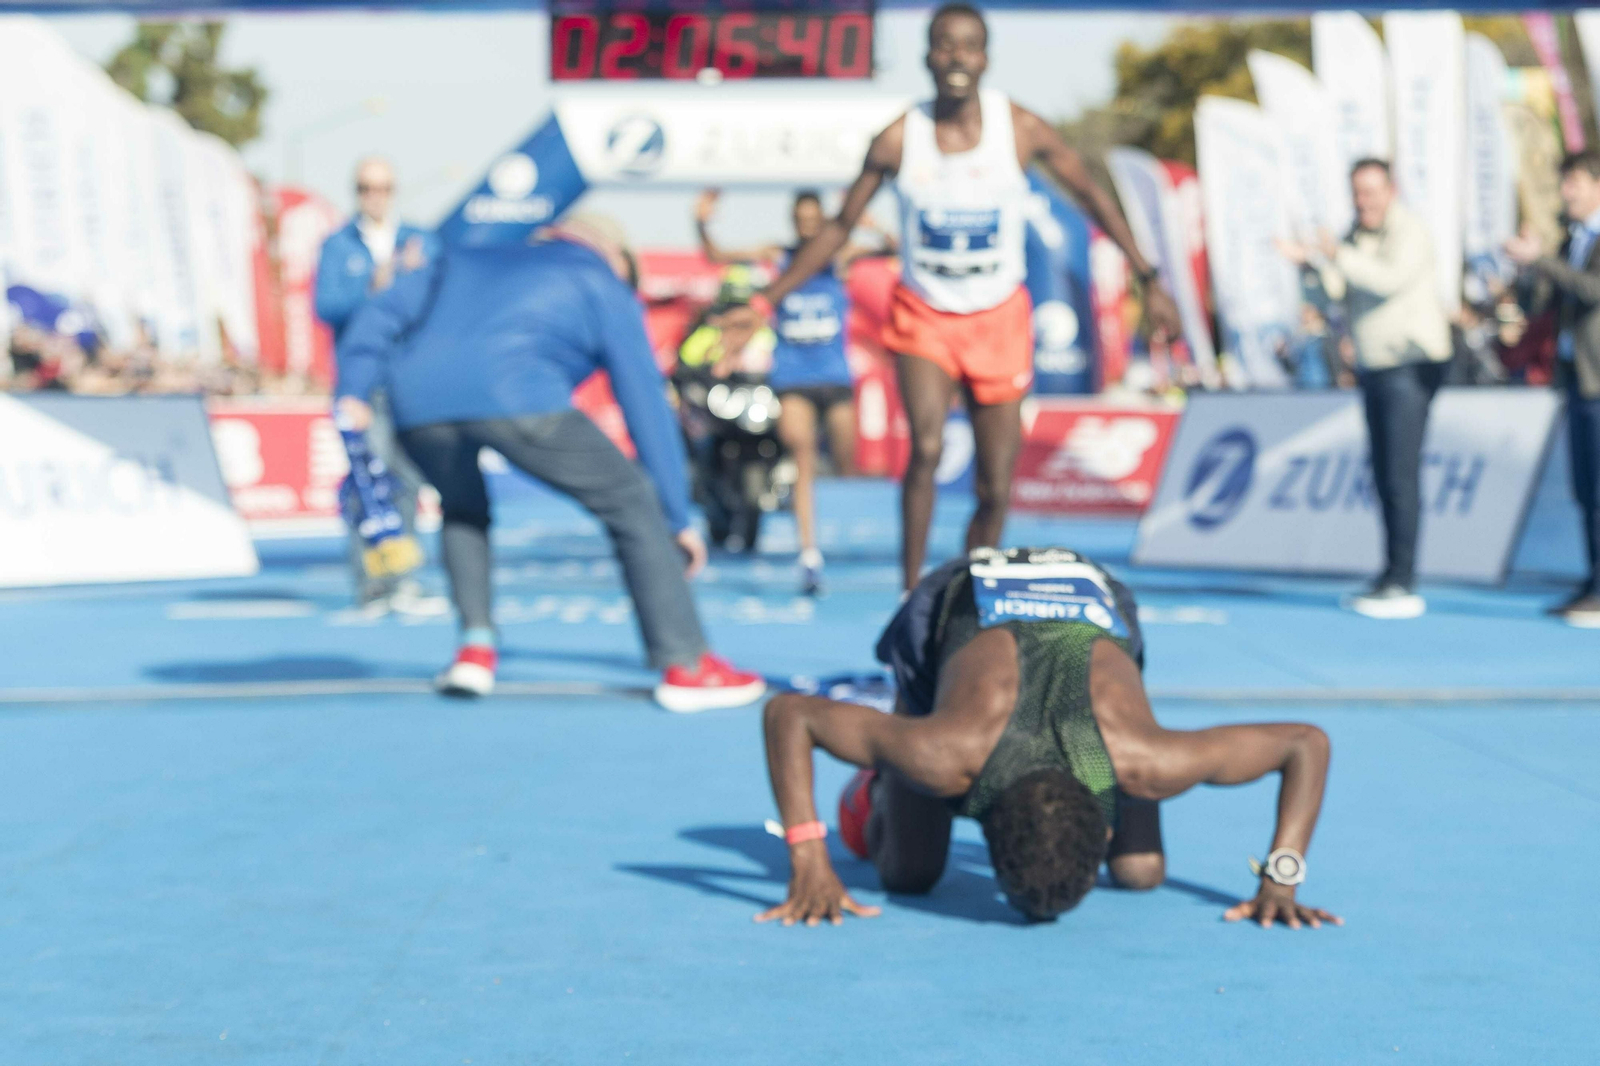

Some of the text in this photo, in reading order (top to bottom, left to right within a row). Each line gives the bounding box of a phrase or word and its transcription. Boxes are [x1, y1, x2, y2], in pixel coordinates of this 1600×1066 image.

[551, 13, 872, 80] 02:06:40
[1267, 451, 1486, 515] ZURH
[994, 597, 1082, 620] ZURICH
